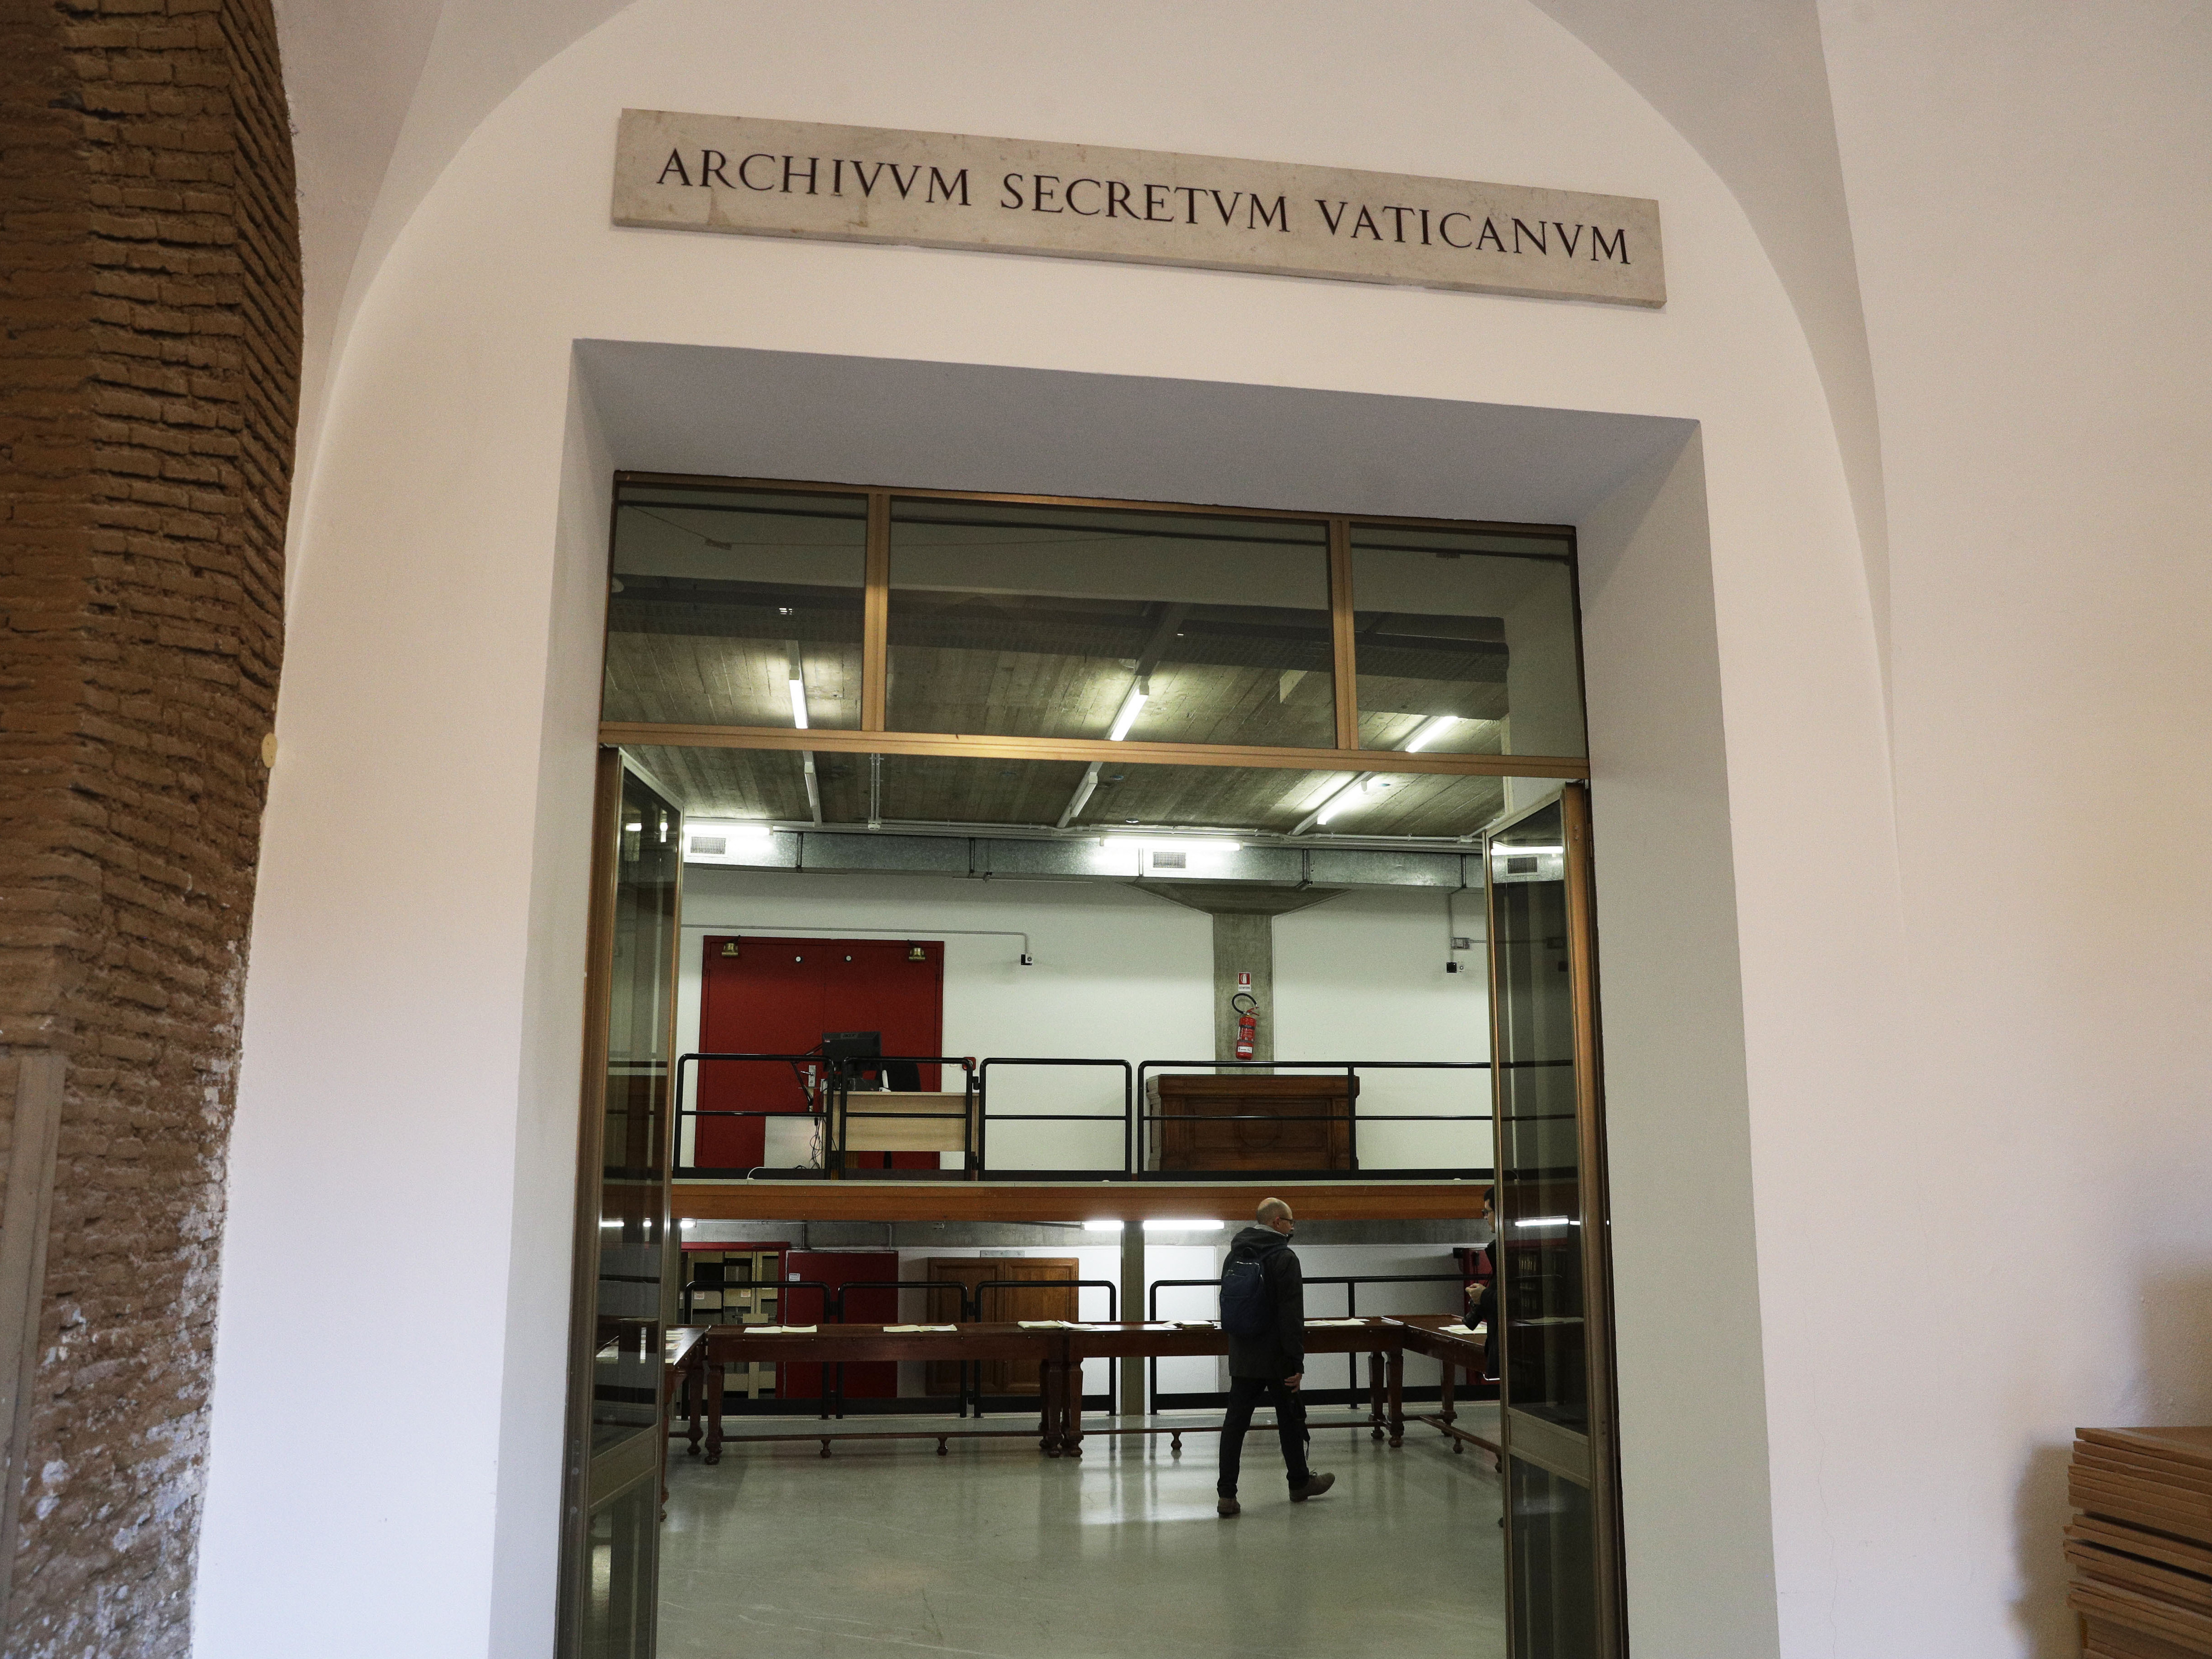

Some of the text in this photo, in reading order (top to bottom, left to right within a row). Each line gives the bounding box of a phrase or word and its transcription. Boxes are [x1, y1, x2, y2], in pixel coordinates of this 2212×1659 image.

[656, 148, 1630, 265] ARCHIVVM SECRETVM VATICANVM
